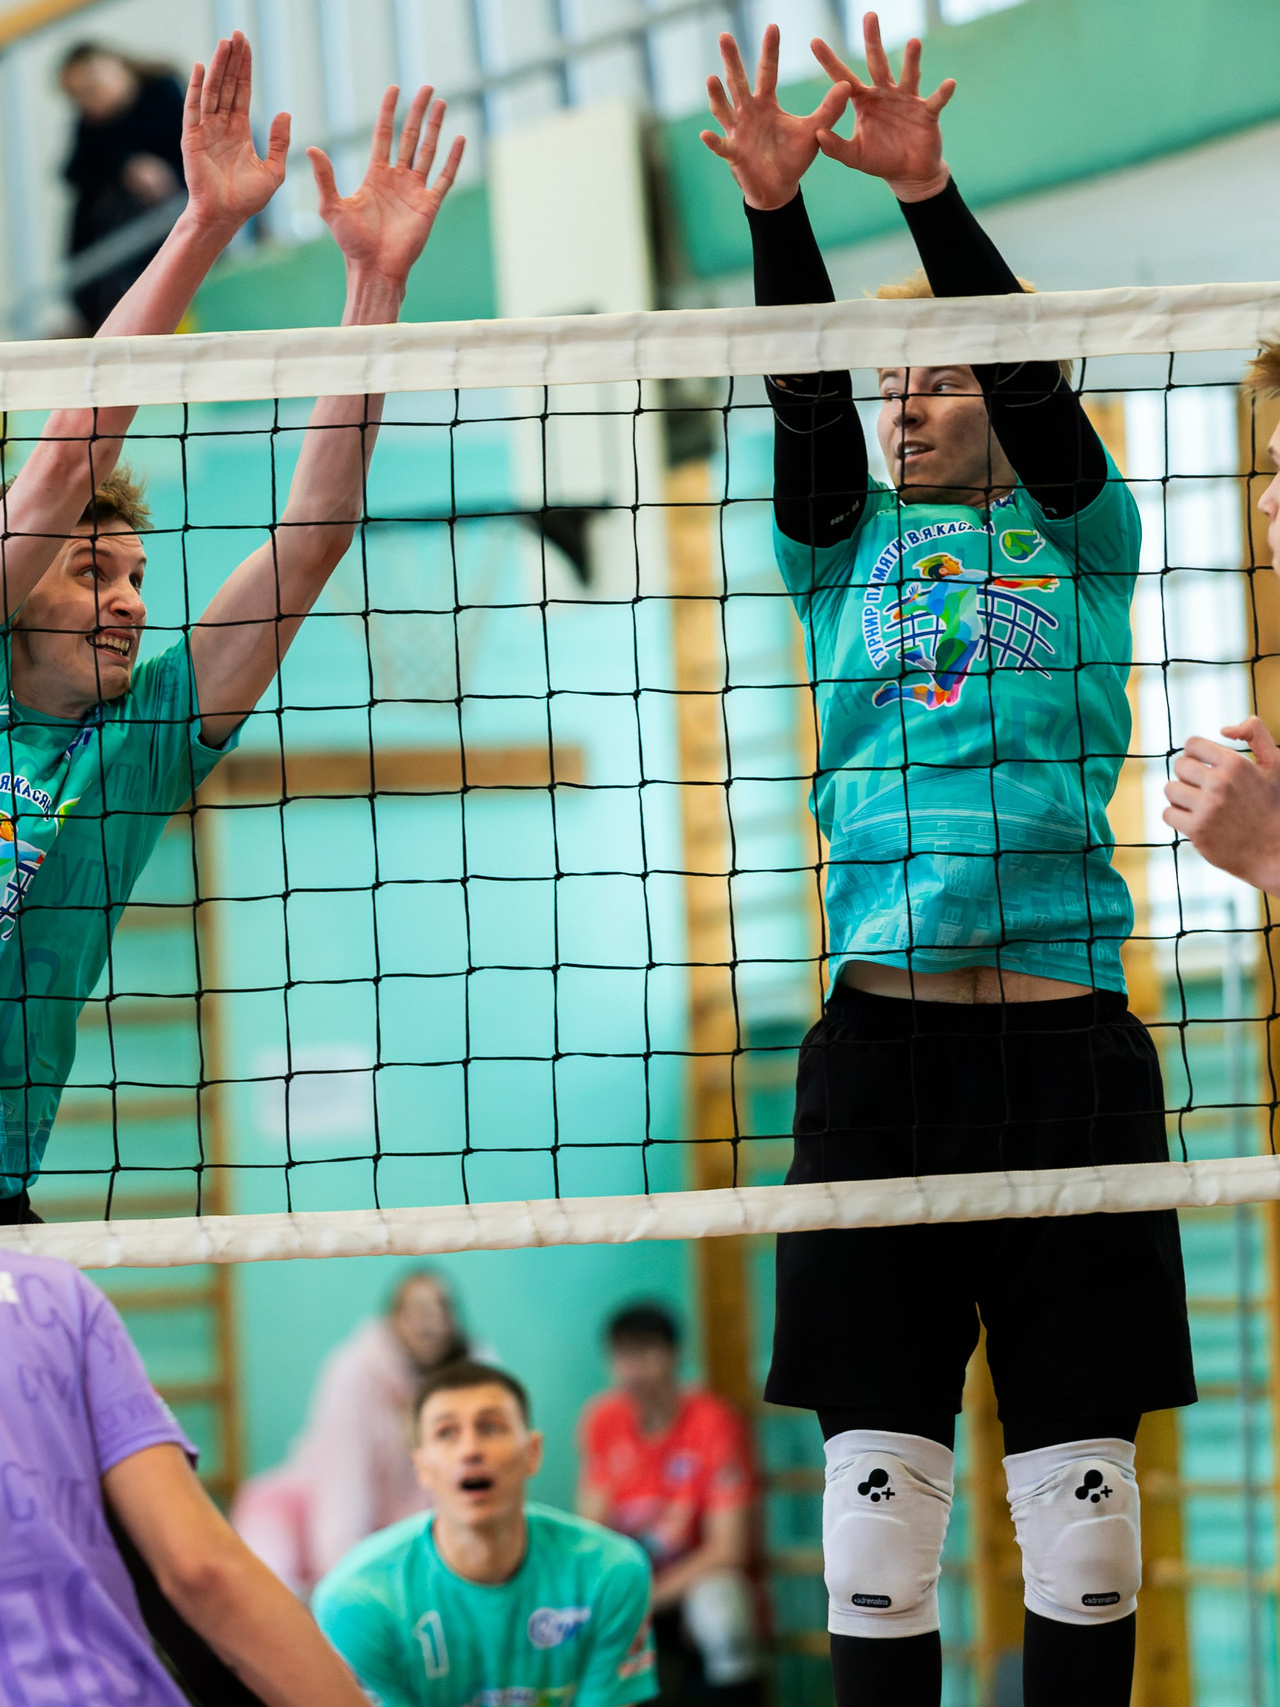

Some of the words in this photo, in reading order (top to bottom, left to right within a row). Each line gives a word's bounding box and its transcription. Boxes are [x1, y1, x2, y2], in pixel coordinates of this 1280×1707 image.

[865, 538, 908, 602] ПАМЯТИ
[863, 607, 887, 669] ТУРНИР
[411, 1609, 450, 1681] 1
